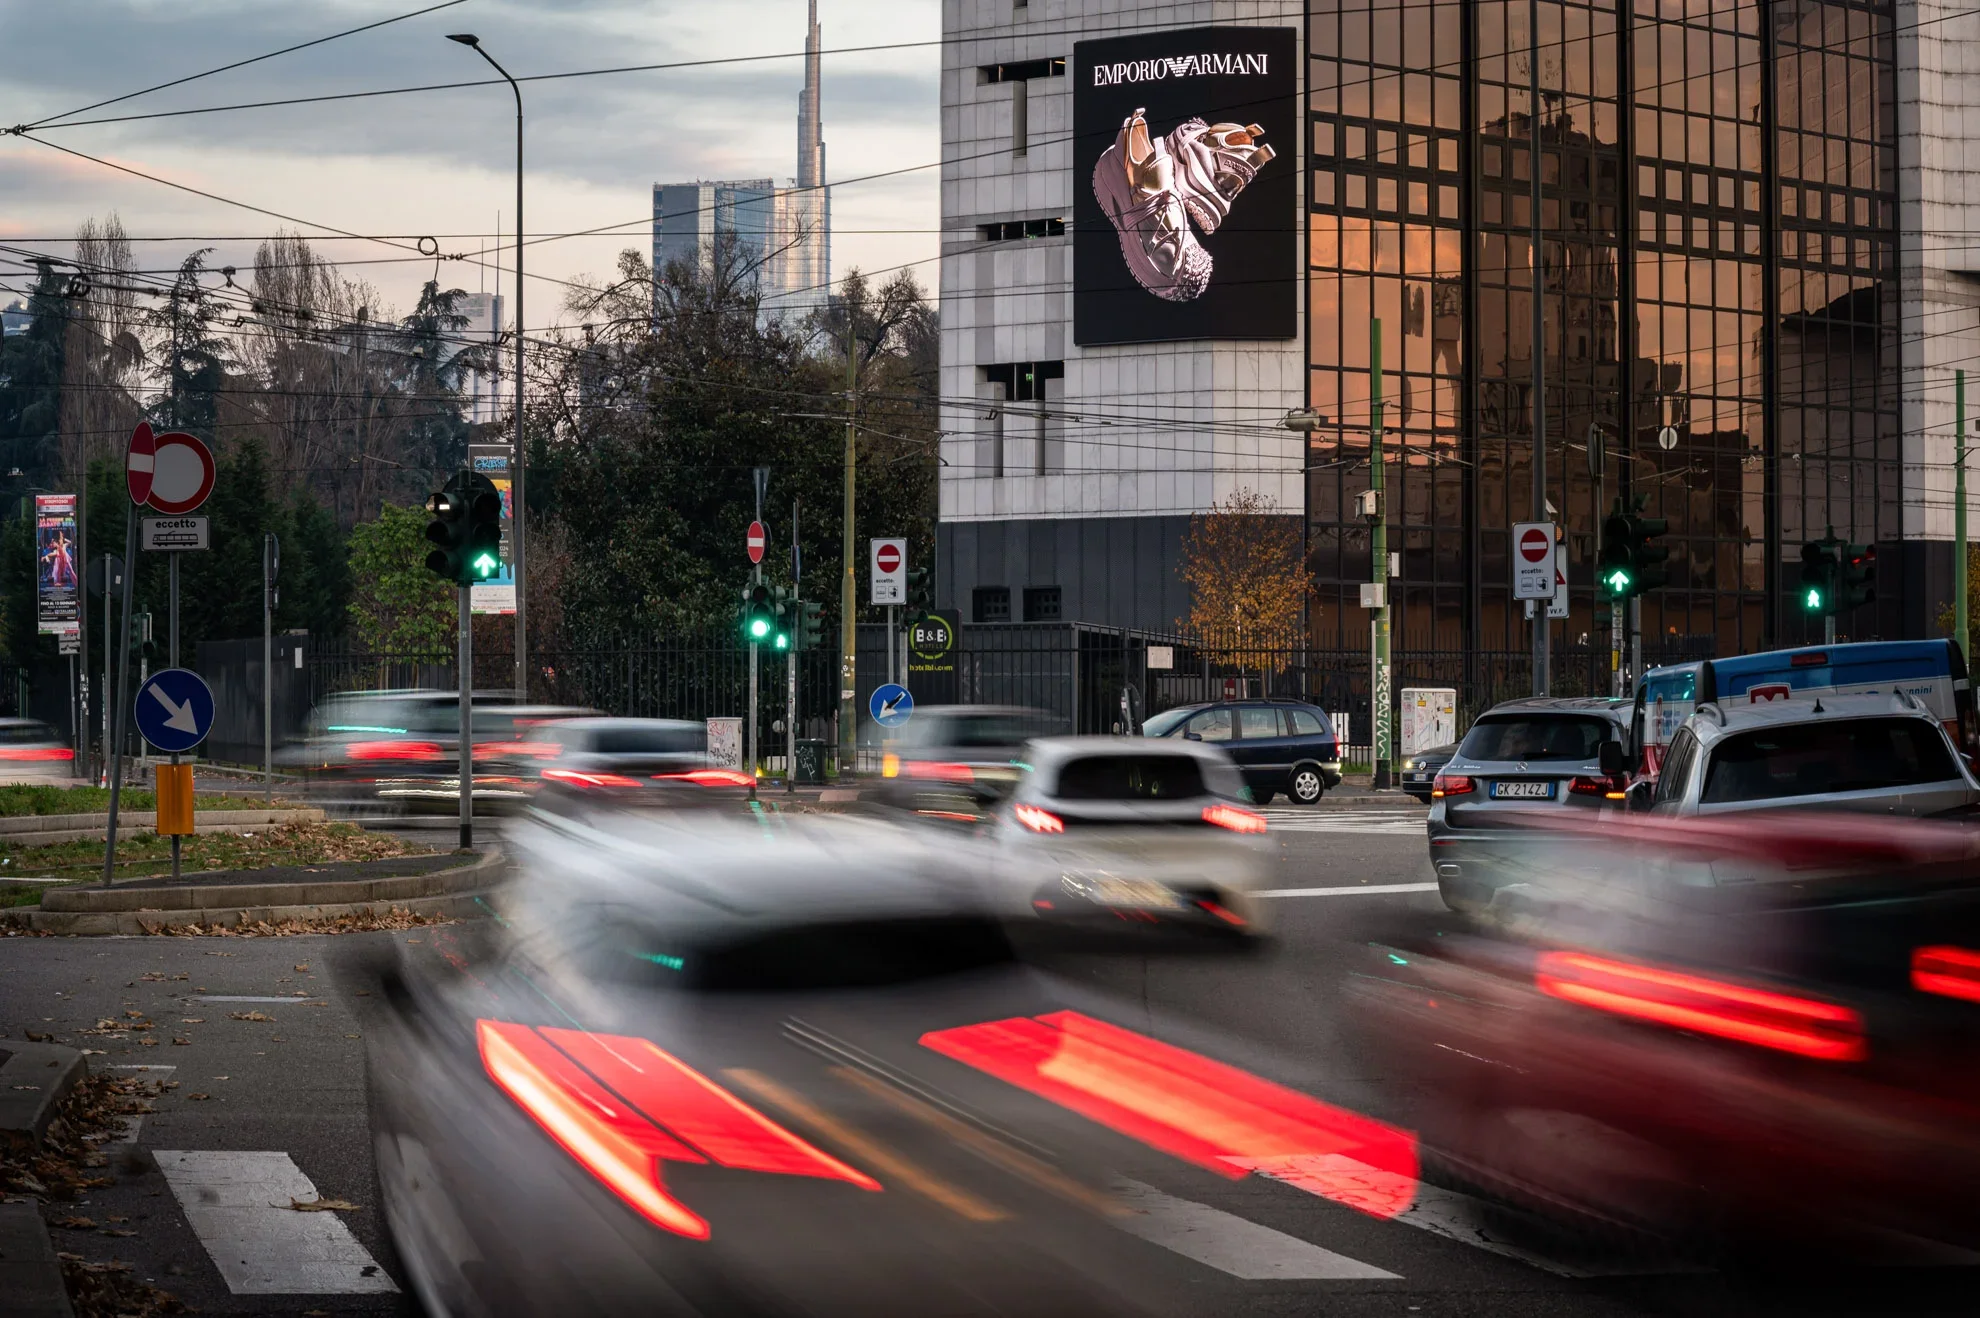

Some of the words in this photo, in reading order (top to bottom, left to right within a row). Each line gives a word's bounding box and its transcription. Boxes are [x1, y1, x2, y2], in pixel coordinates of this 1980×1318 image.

[1094, 57, 1168, 87] EMPORIO
[1189, 53, 1269, 76] ARMANI
[155, 519, 197, 528] eccetto
[1514, 783, 1548, 796] 214ZJ
